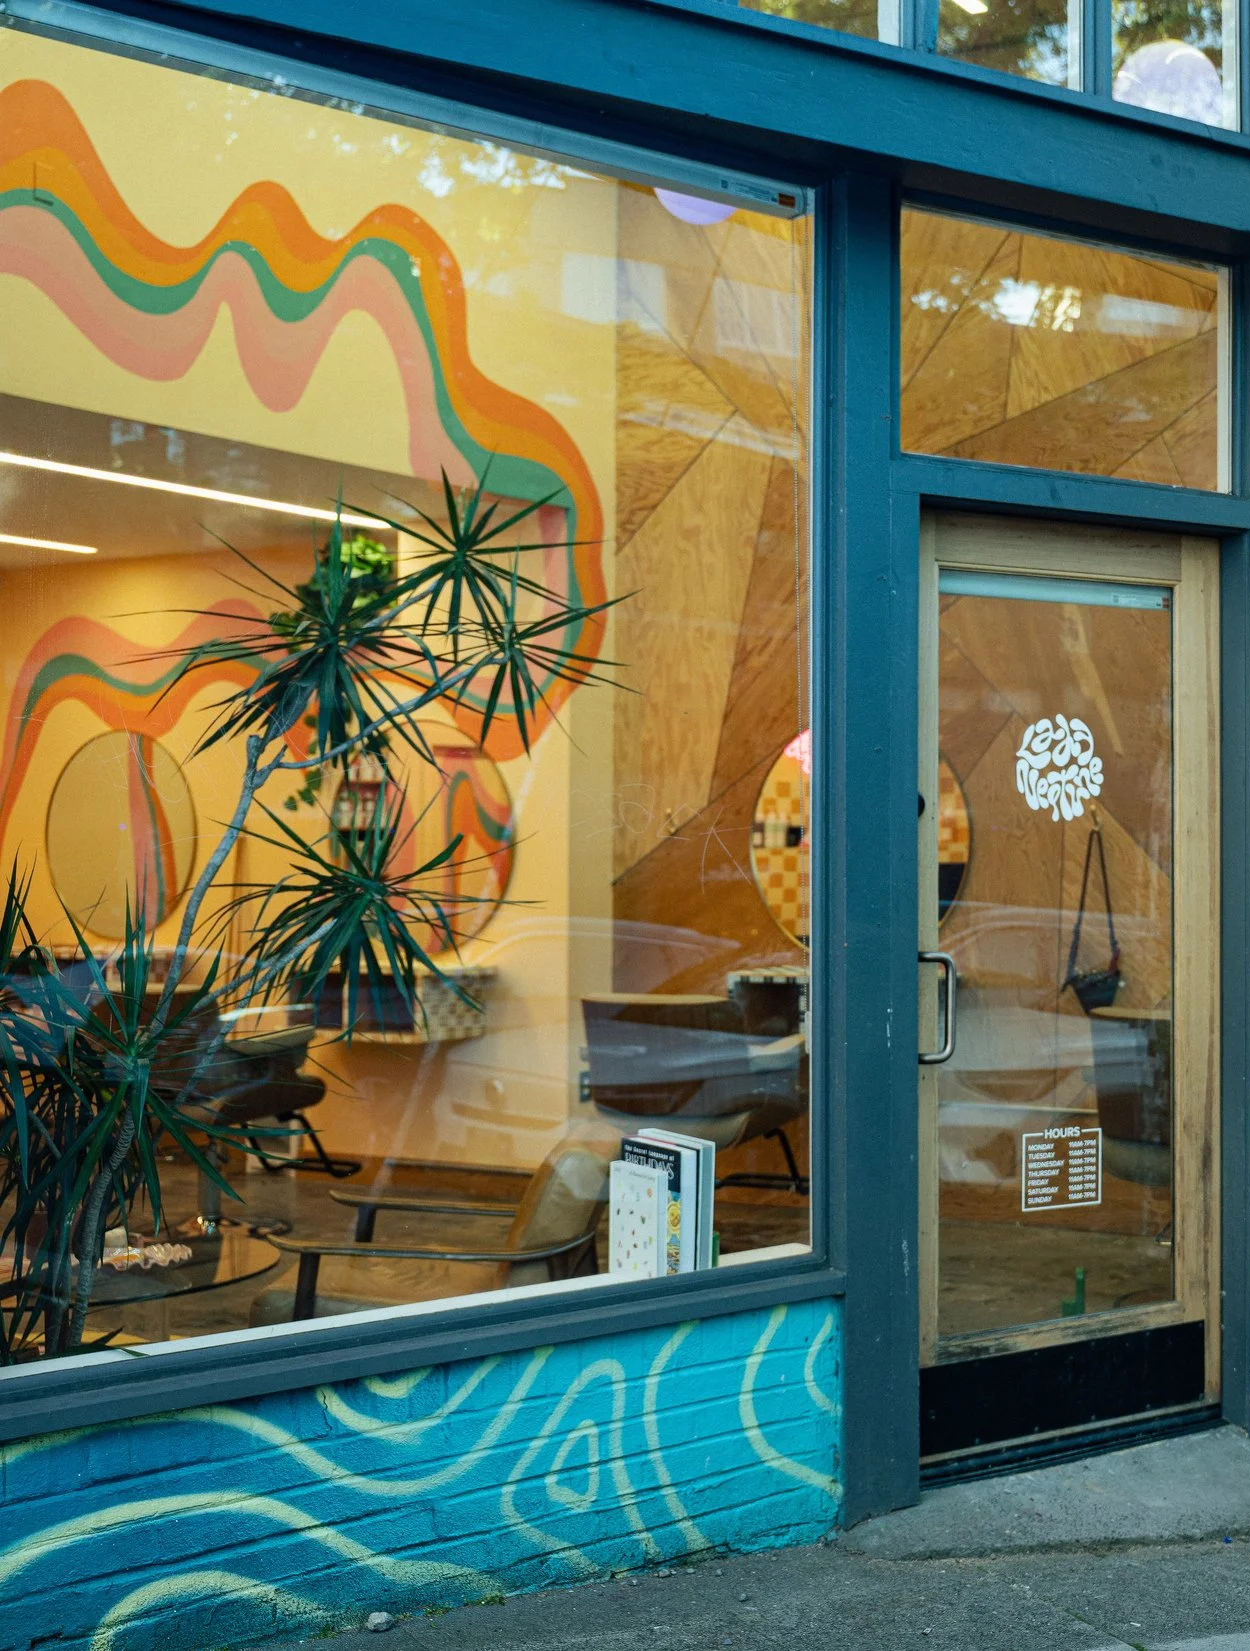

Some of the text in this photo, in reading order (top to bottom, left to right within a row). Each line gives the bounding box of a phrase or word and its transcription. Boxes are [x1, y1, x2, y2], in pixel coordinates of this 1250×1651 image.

[1016, 756, 1104, 822] Neptune
[1044, 1127, 1080, 1139] HOURS
[1028, 1143, 1054, 1151] MONDAY
[1028, 1152, 1055, 1160] TUESDAY
[1028, 1160, 1064, 1169] WEDNESDAY
[1028, 1169, 1060, 1177] THURSDAY
[1028, 1186, 1059, 1195] SATURDAY
[1028, 1196, 1052, 1204] SUNDAY
